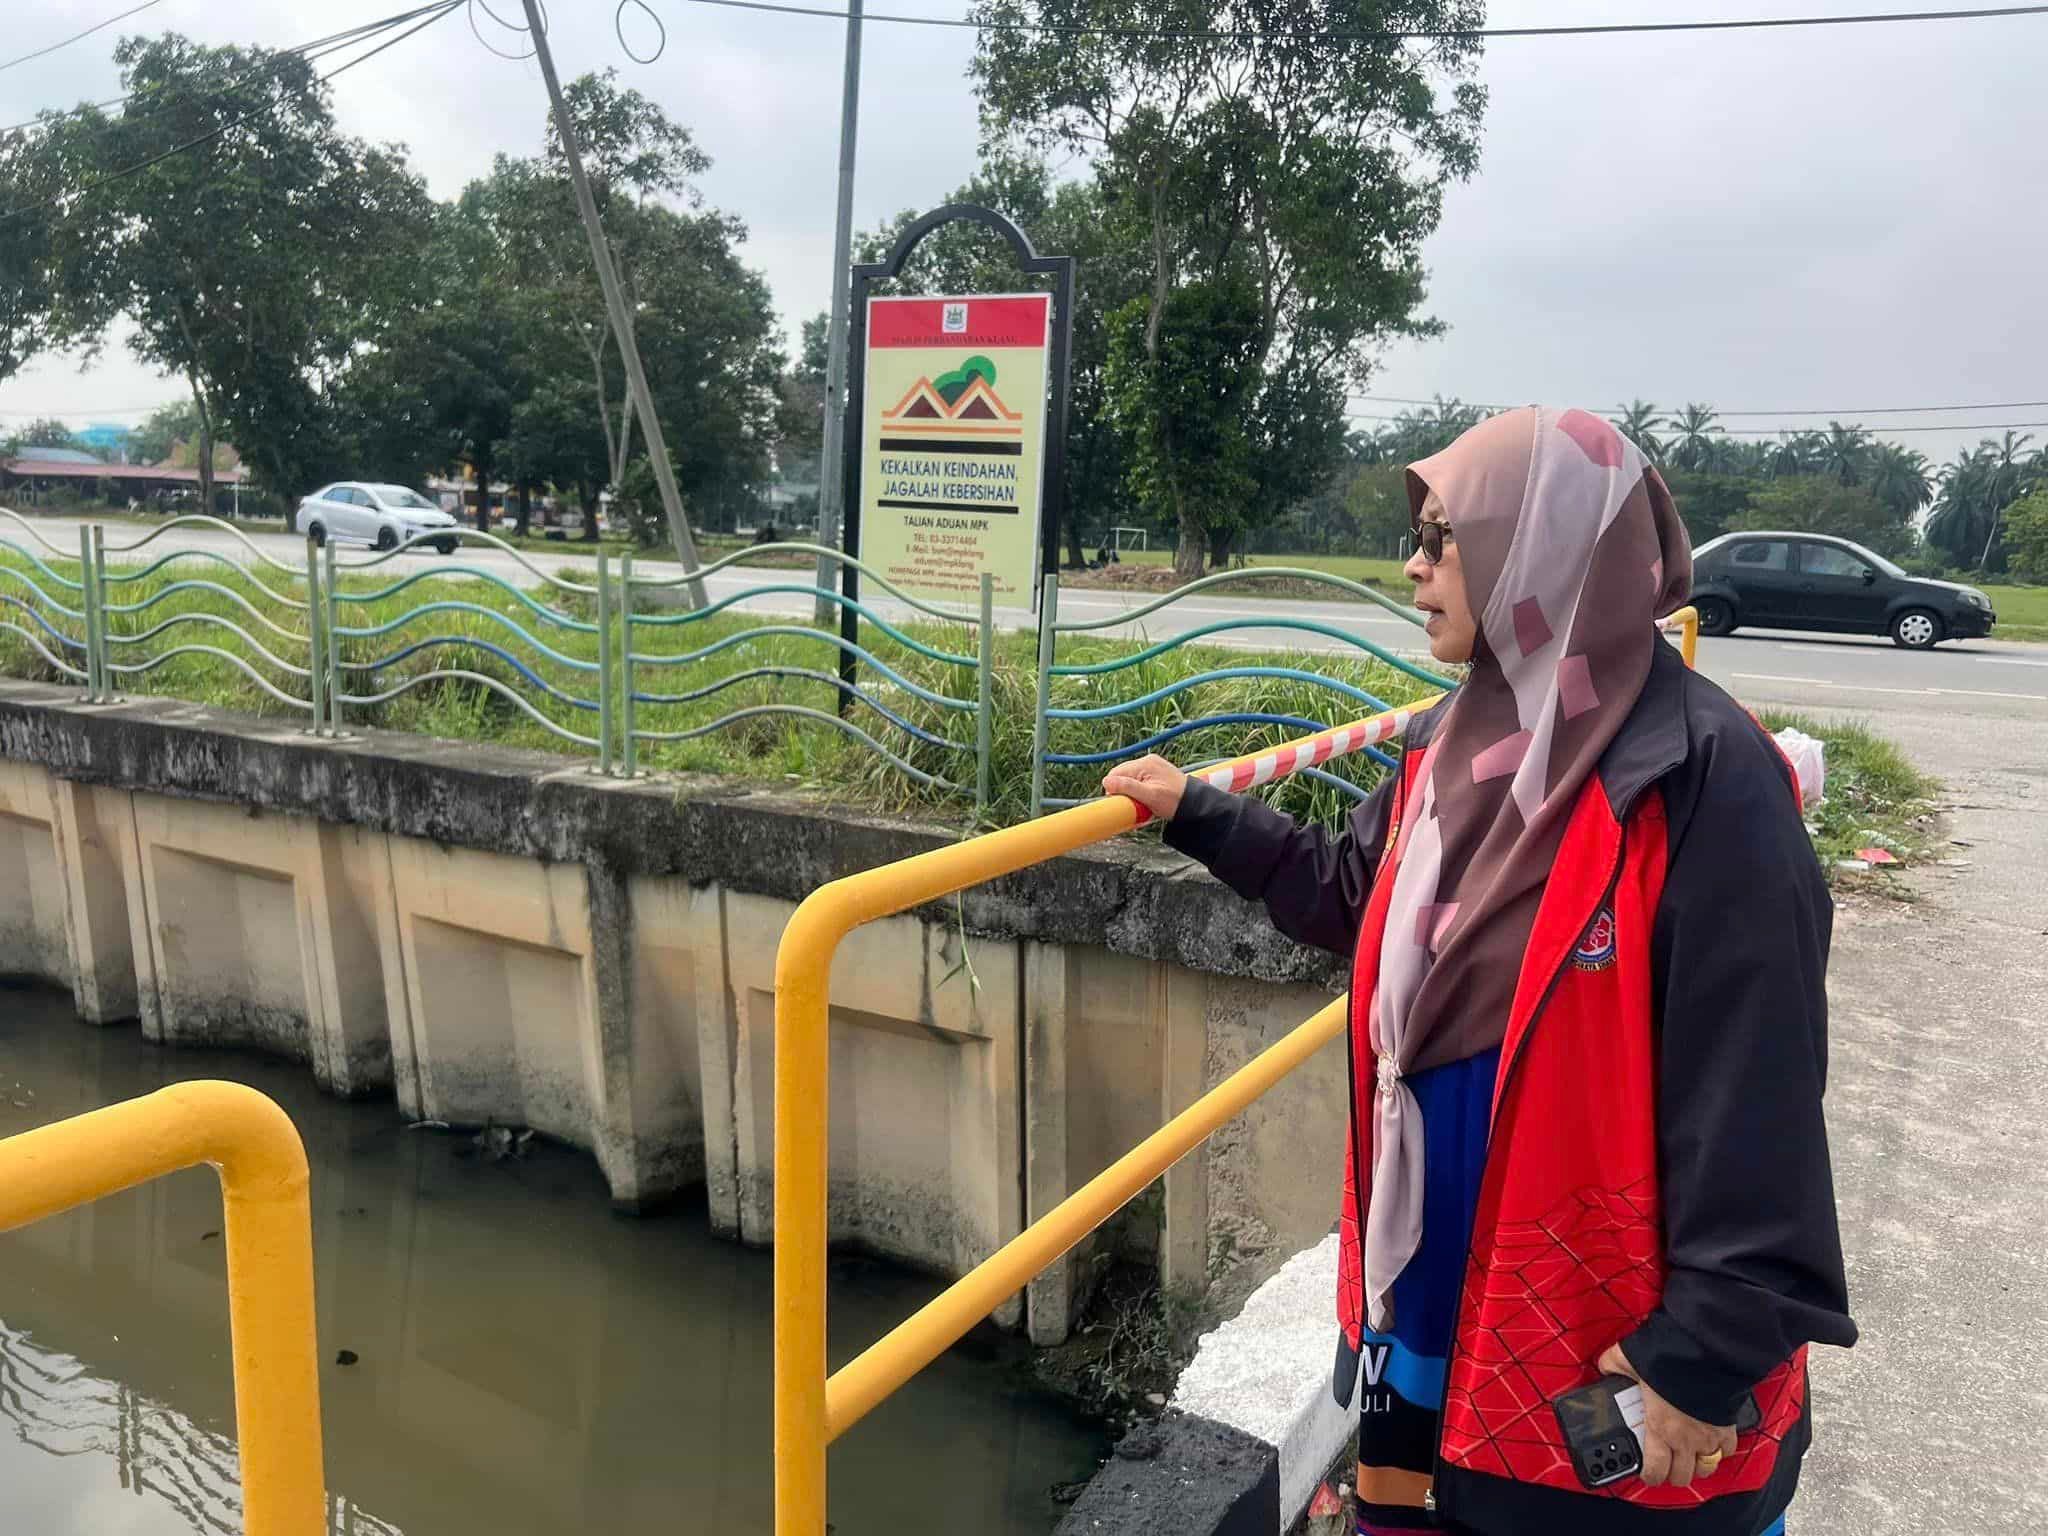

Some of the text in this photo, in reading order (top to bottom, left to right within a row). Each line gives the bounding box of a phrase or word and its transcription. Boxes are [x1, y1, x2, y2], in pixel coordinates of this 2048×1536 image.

[880, 460, 1019, 481] KEKALKAN KEINDAHAN,
[883, 481, 1015, 502] JAGALAH KEBERSIHAN
[904, 515, 989, 531] TALIAN ADUAN MPK
